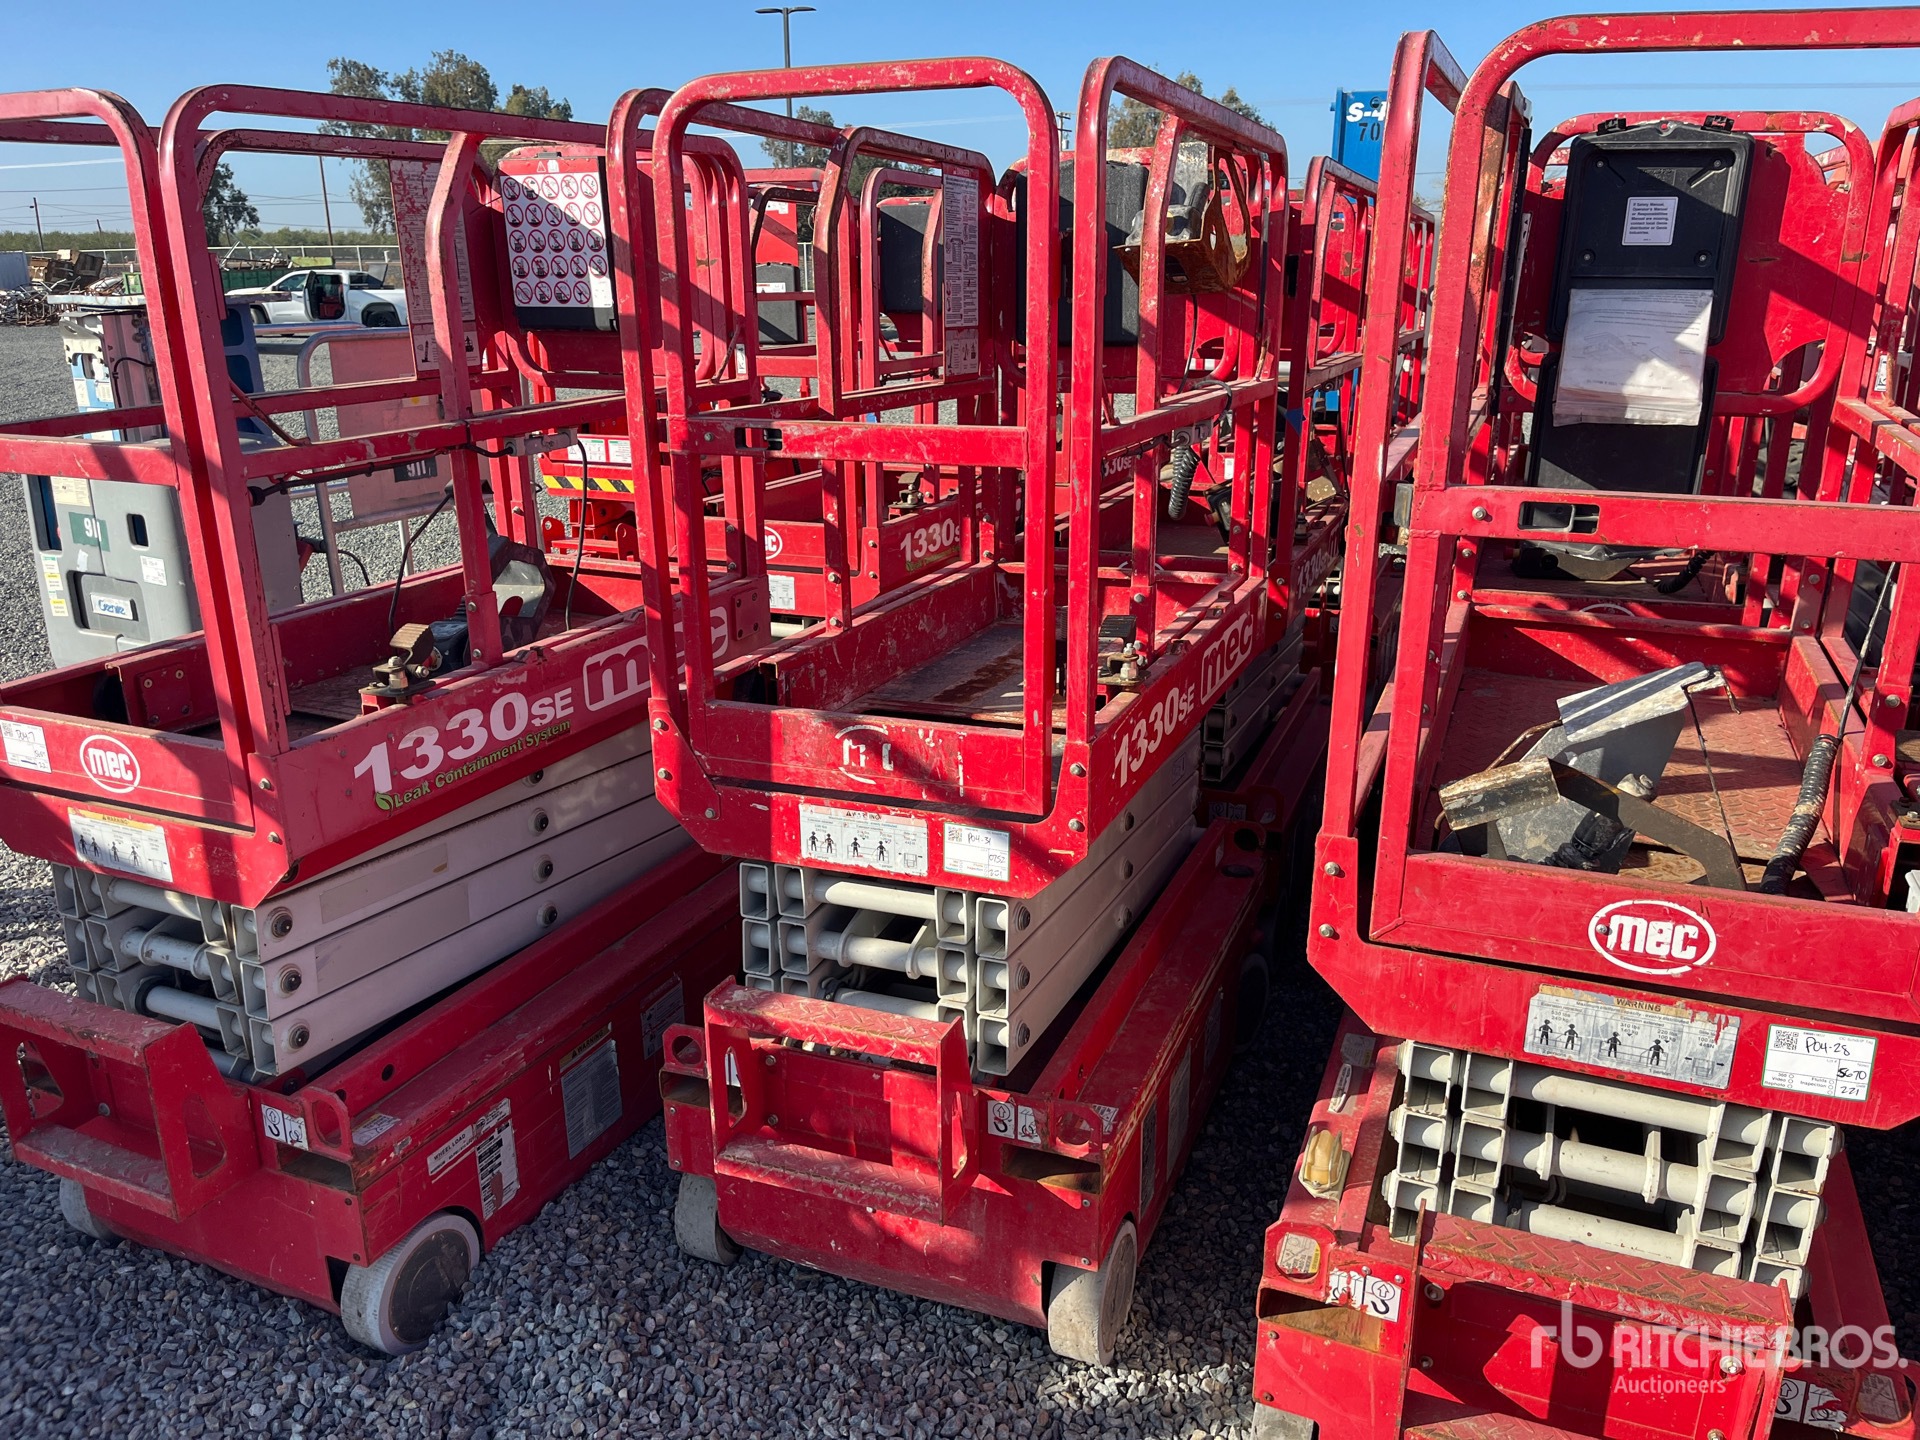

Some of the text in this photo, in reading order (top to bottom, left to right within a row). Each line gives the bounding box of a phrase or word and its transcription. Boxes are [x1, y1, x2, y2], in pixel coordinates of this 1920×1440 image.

[87, 747, 134, 781] mec
[353, 686, 574, 795] 1330SE
[394, 718, 571, 808] Leak Containment System
[1114, 682, 1196, 788] 1330SE
[1606, 914, 1699, 960] mec
[1615, 997, 1662, 1013] WARNING
